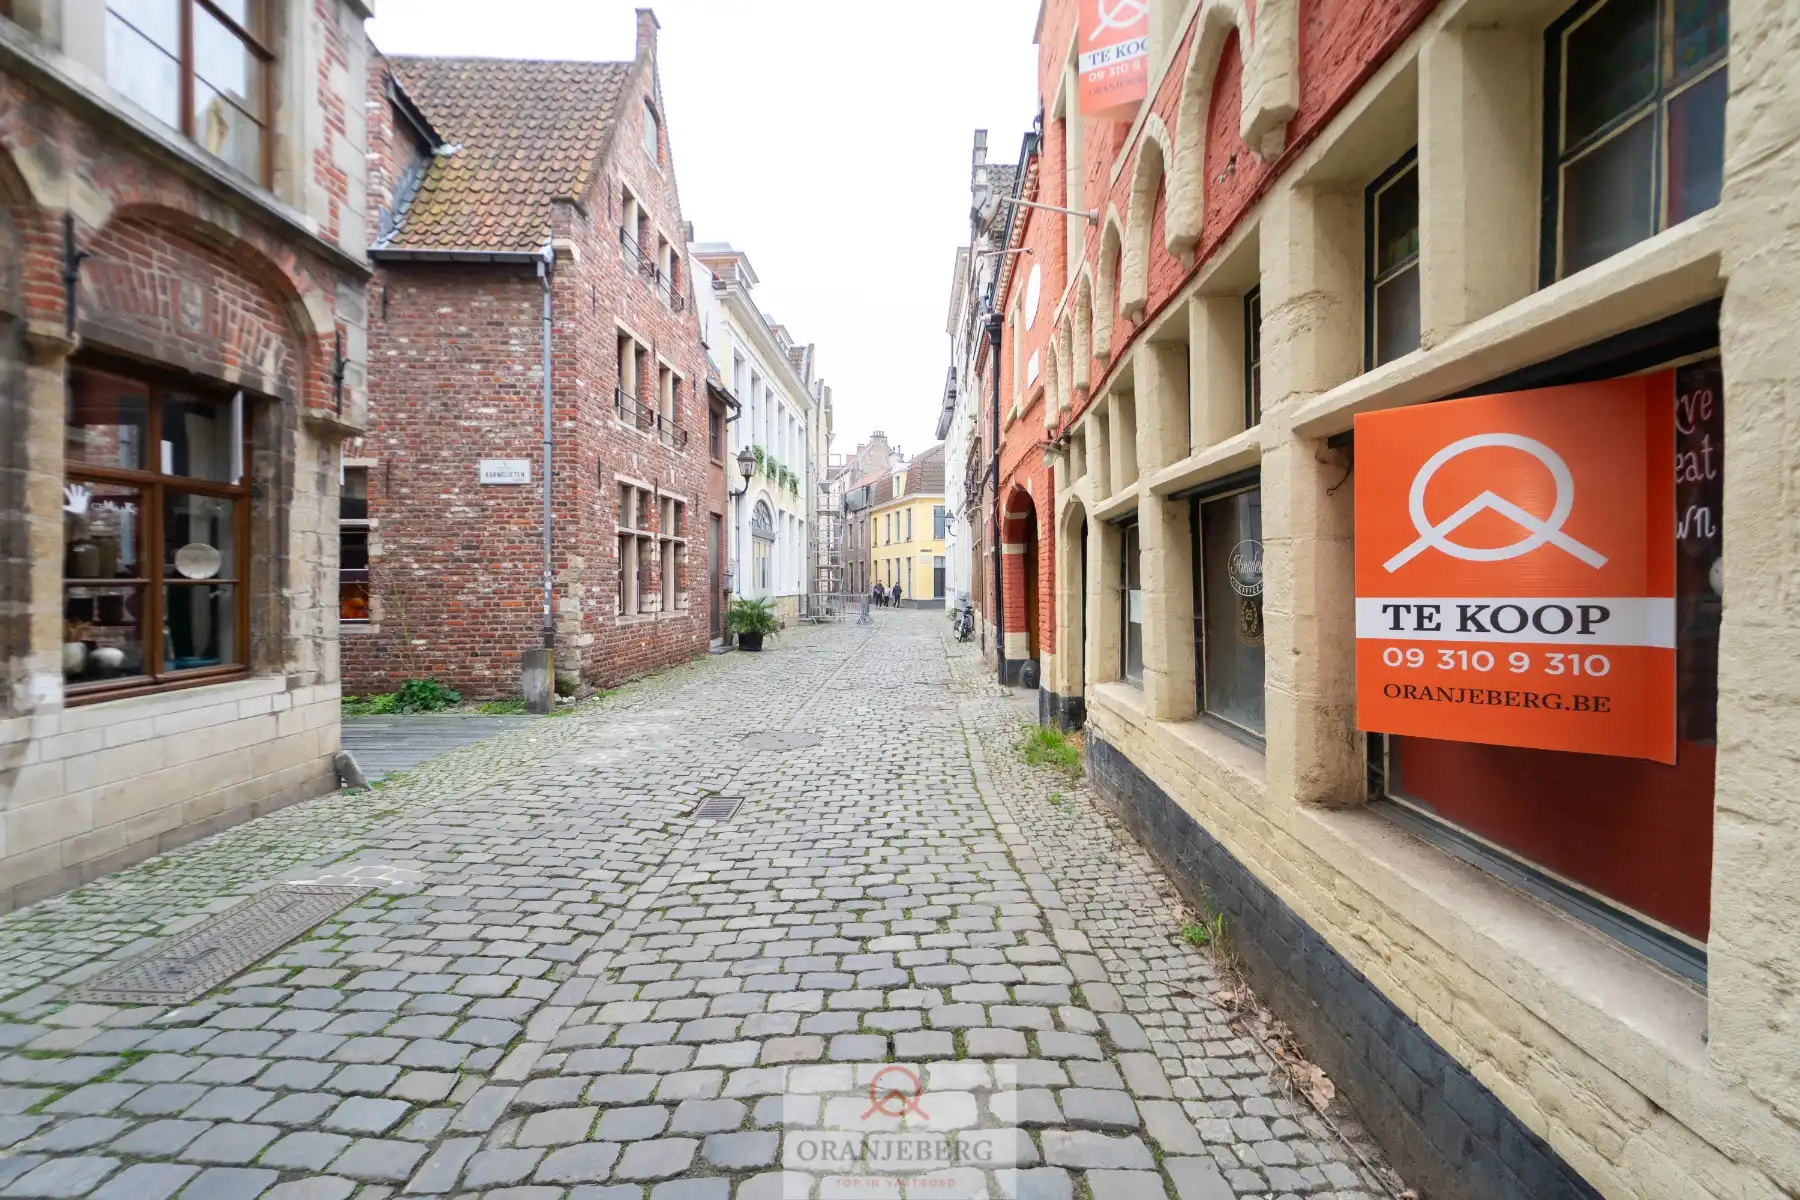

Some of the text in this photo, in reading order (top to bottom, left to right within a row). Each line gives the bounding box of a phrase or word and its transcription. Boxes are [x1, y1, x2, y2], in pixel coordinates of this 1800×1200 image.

[1088, 49, 1111, 66] TE
[1676, 389, 1712, 434] ve
[1382, 604, 1611, 635] TE KOOP
[1382, 647, 1611, 677] 09 310 9 310
[1383, 683, 1611, 713] ORANJEBERG.BE
